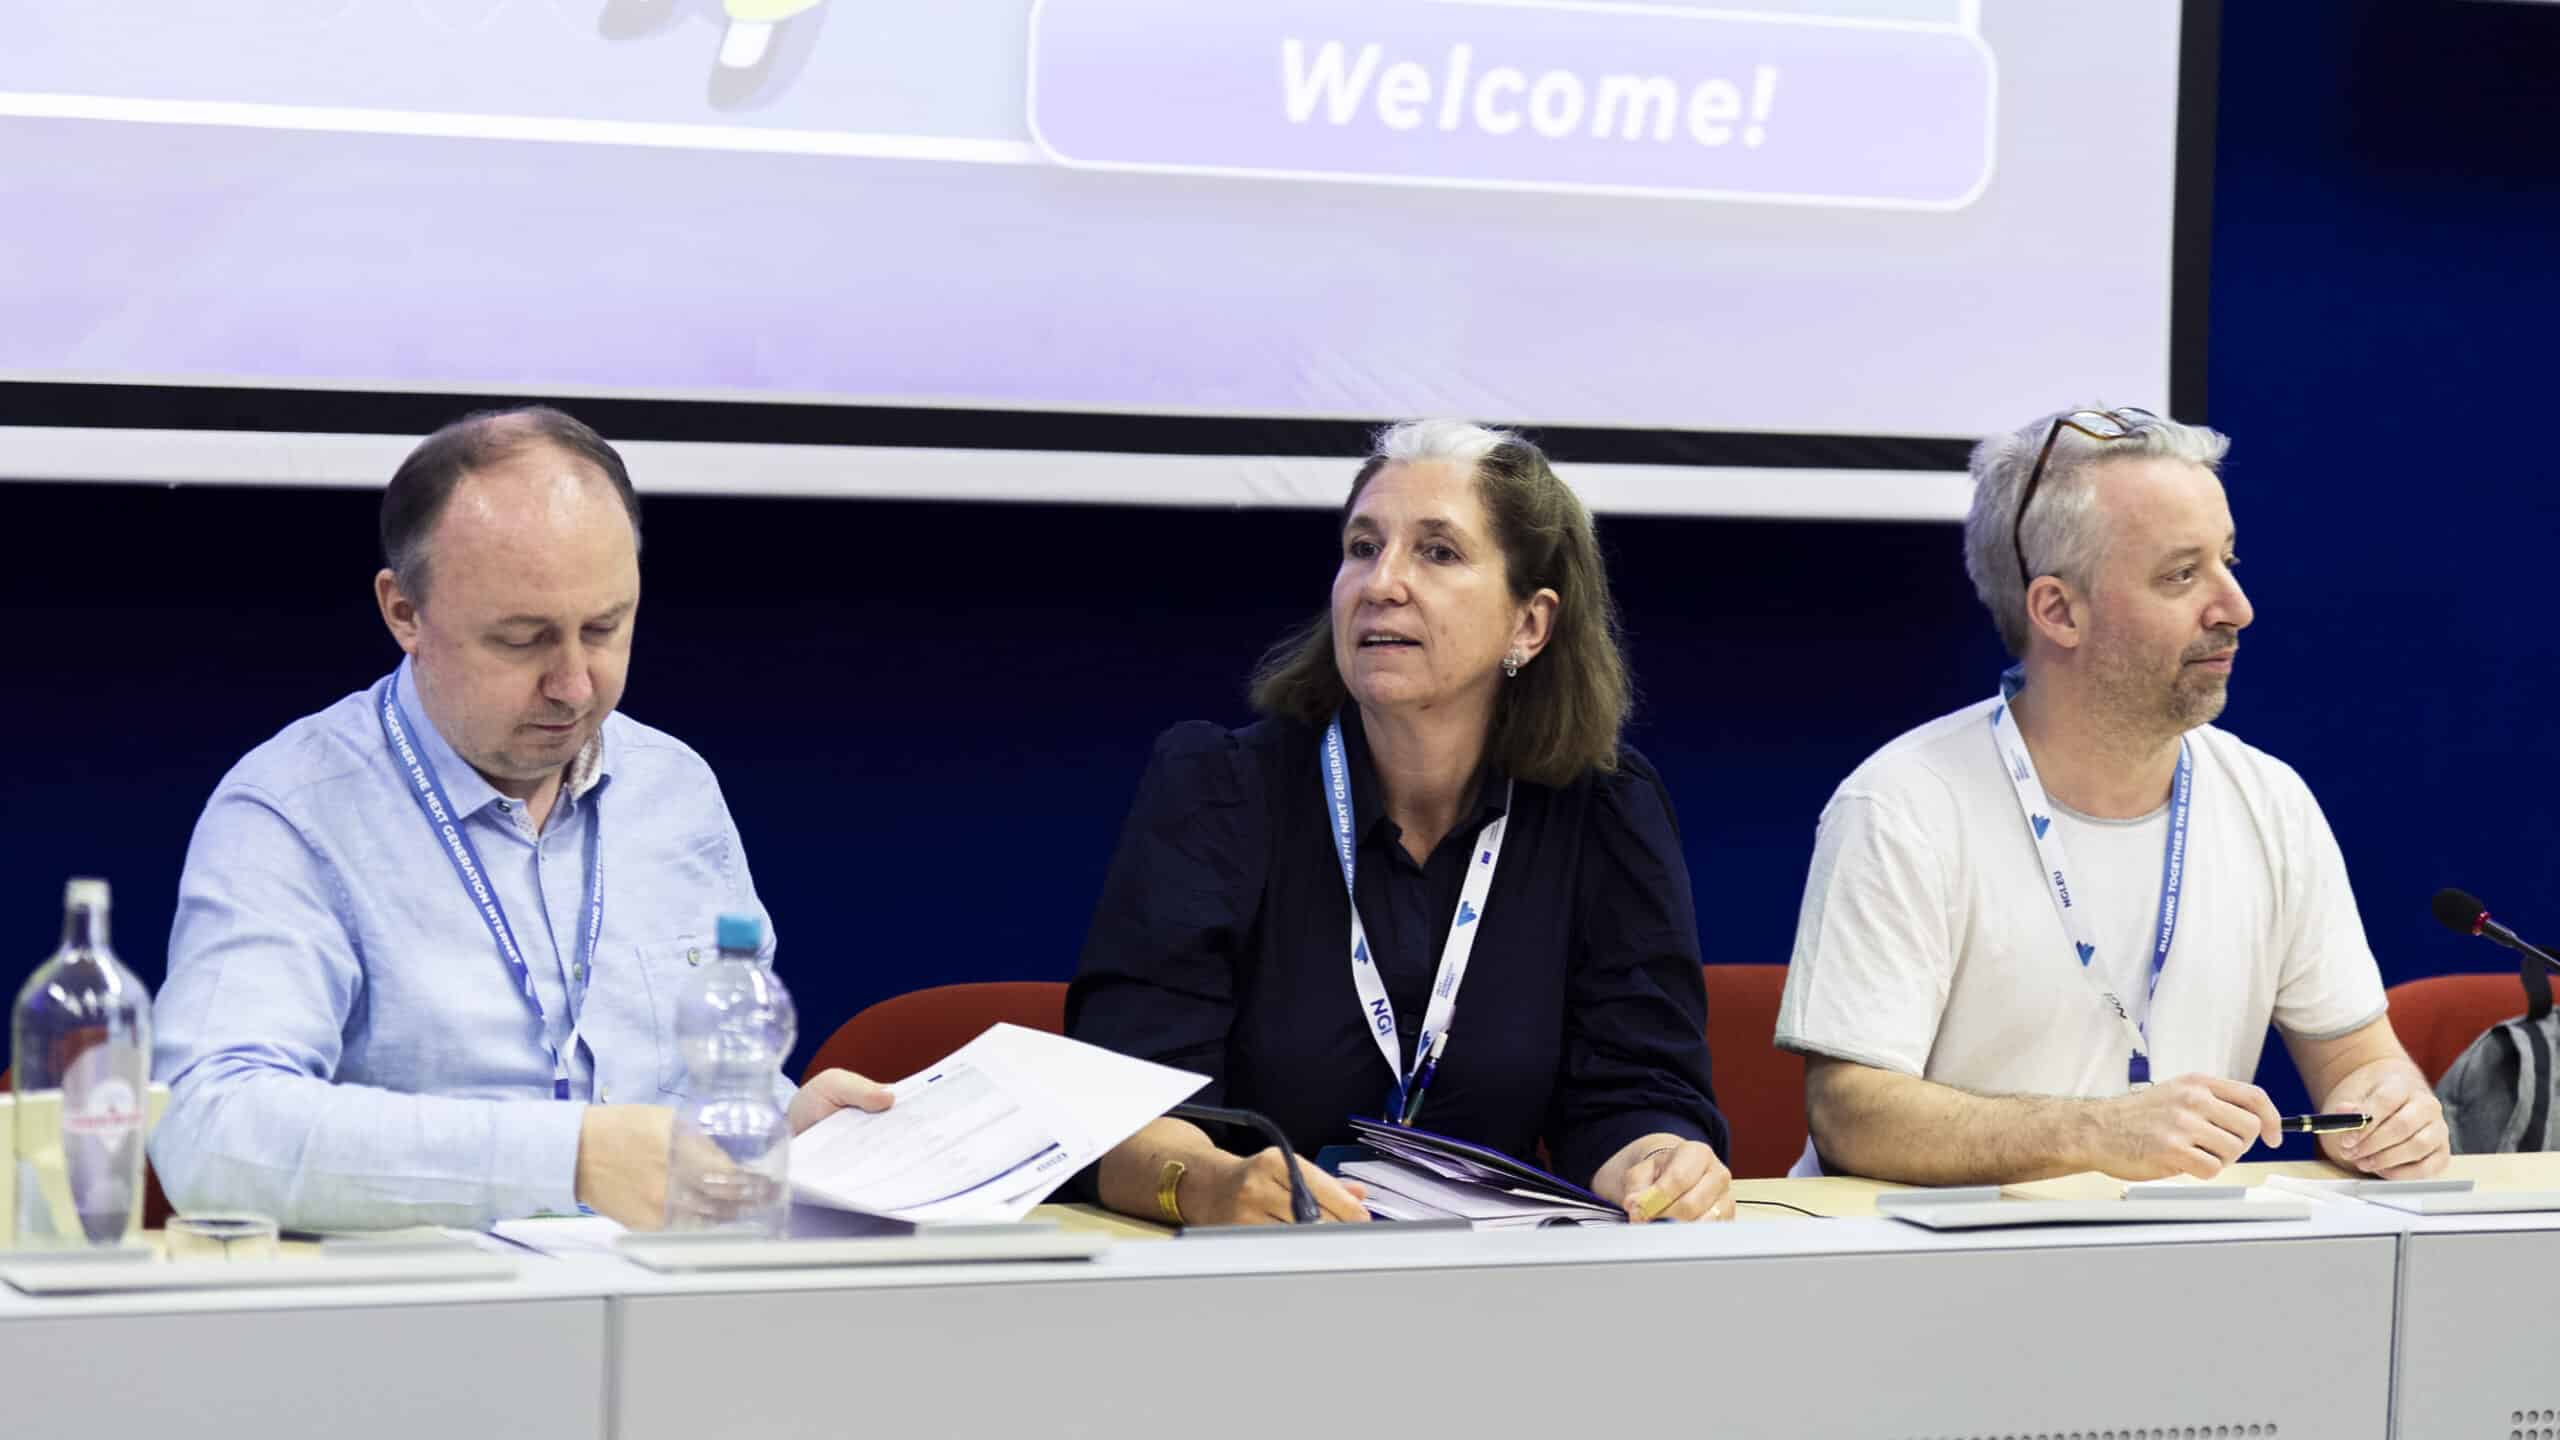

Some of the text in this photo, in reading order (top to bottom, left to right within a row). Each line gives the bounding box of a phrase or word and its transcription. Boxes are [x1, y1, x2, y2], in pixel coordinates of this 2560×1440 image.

[1280, 38, 1778, 149] Welcome!
[2179, 769, 2191, 799] NEXT
[384, 703, 418, 765] TOGETHER
[410, 765, 430, 792] THE
[425, 791, 449, 824] NEXT
[442, 825, 489, 905] GENERATION
[485, 904, 522, 965] INTERNET
[1338, 801, 1352, 833] NEXT
[2175, 800, 2186, 825] THE
[2169, 826, 2183, 893] TOGETHER
[2159, 894, 2176, 953] BUILDING
[1369, 998, 1392, 1036] NGI
